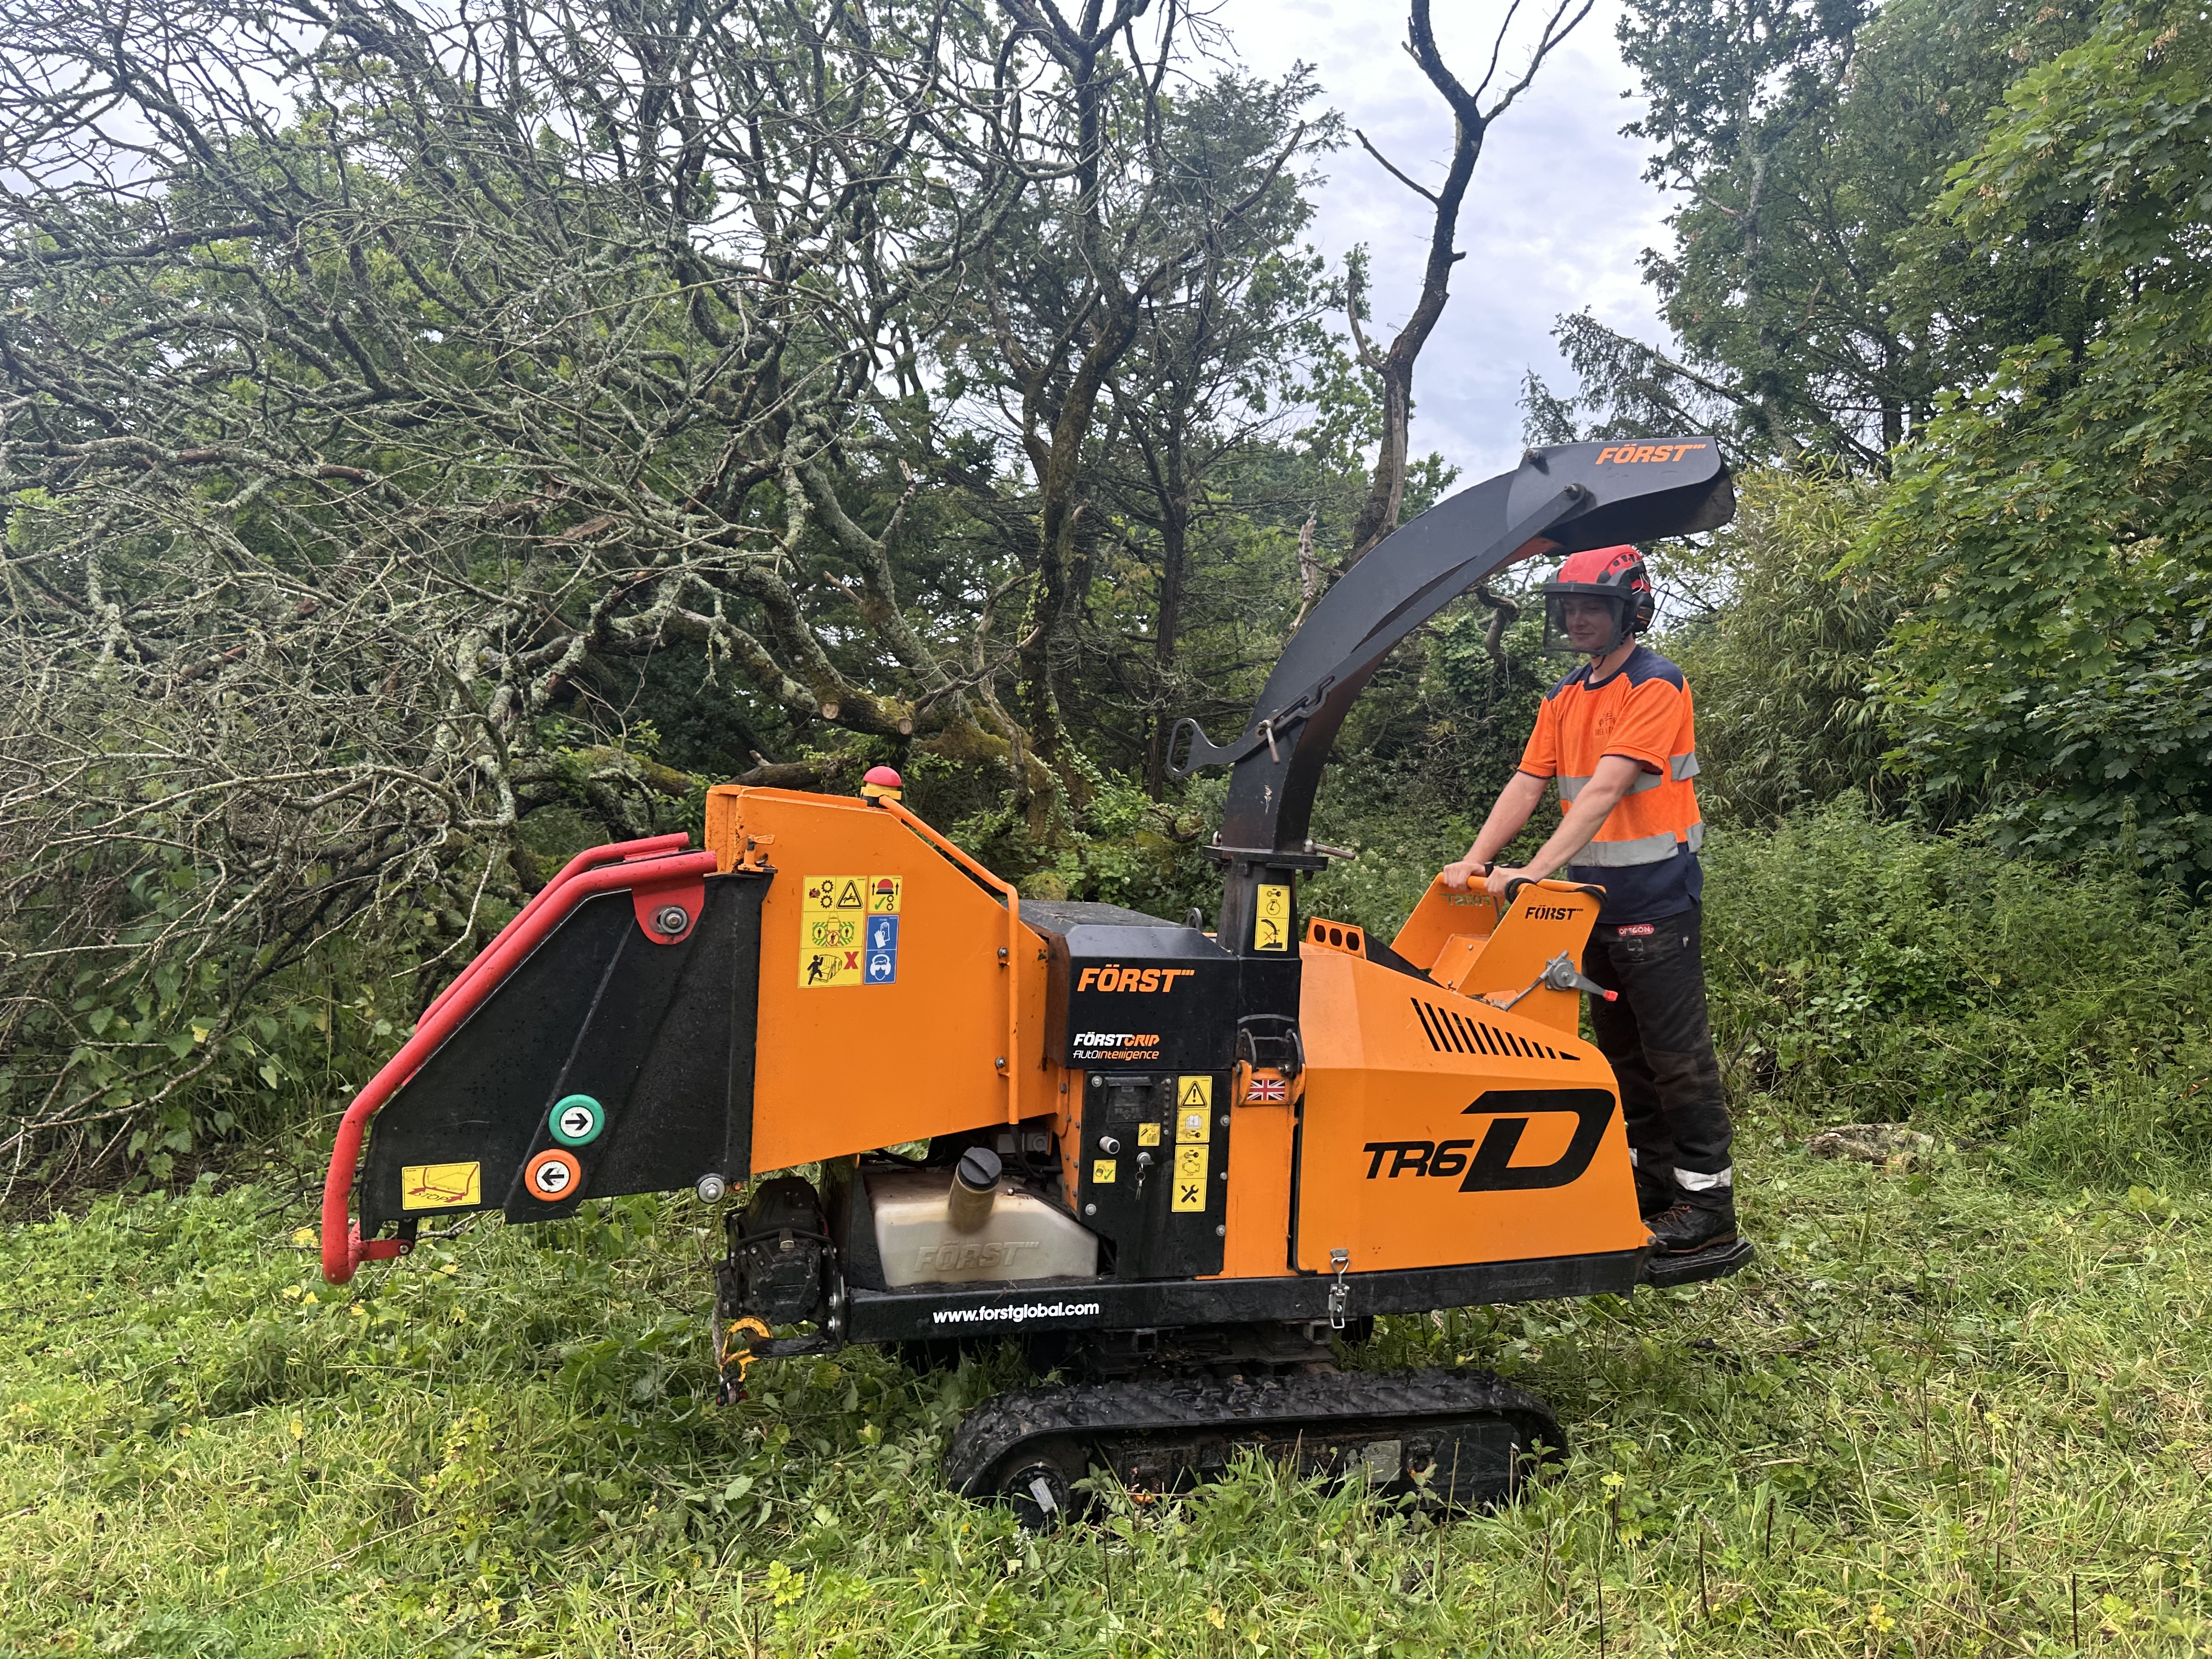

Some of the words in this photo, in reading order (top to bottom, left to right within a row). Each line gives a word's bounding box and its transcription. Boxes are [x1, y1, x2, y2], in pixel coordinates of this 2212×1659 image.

[1595, 443, 1706, 465] FÖRST
[1525, 905, 1583, 920] FÖRST
[1077, 964, 1195, 992] FÖRST
[913, 1240, 1039, 1272] FÖRST
[933, 1302, 1099, 1323] www.forstglobal.com
